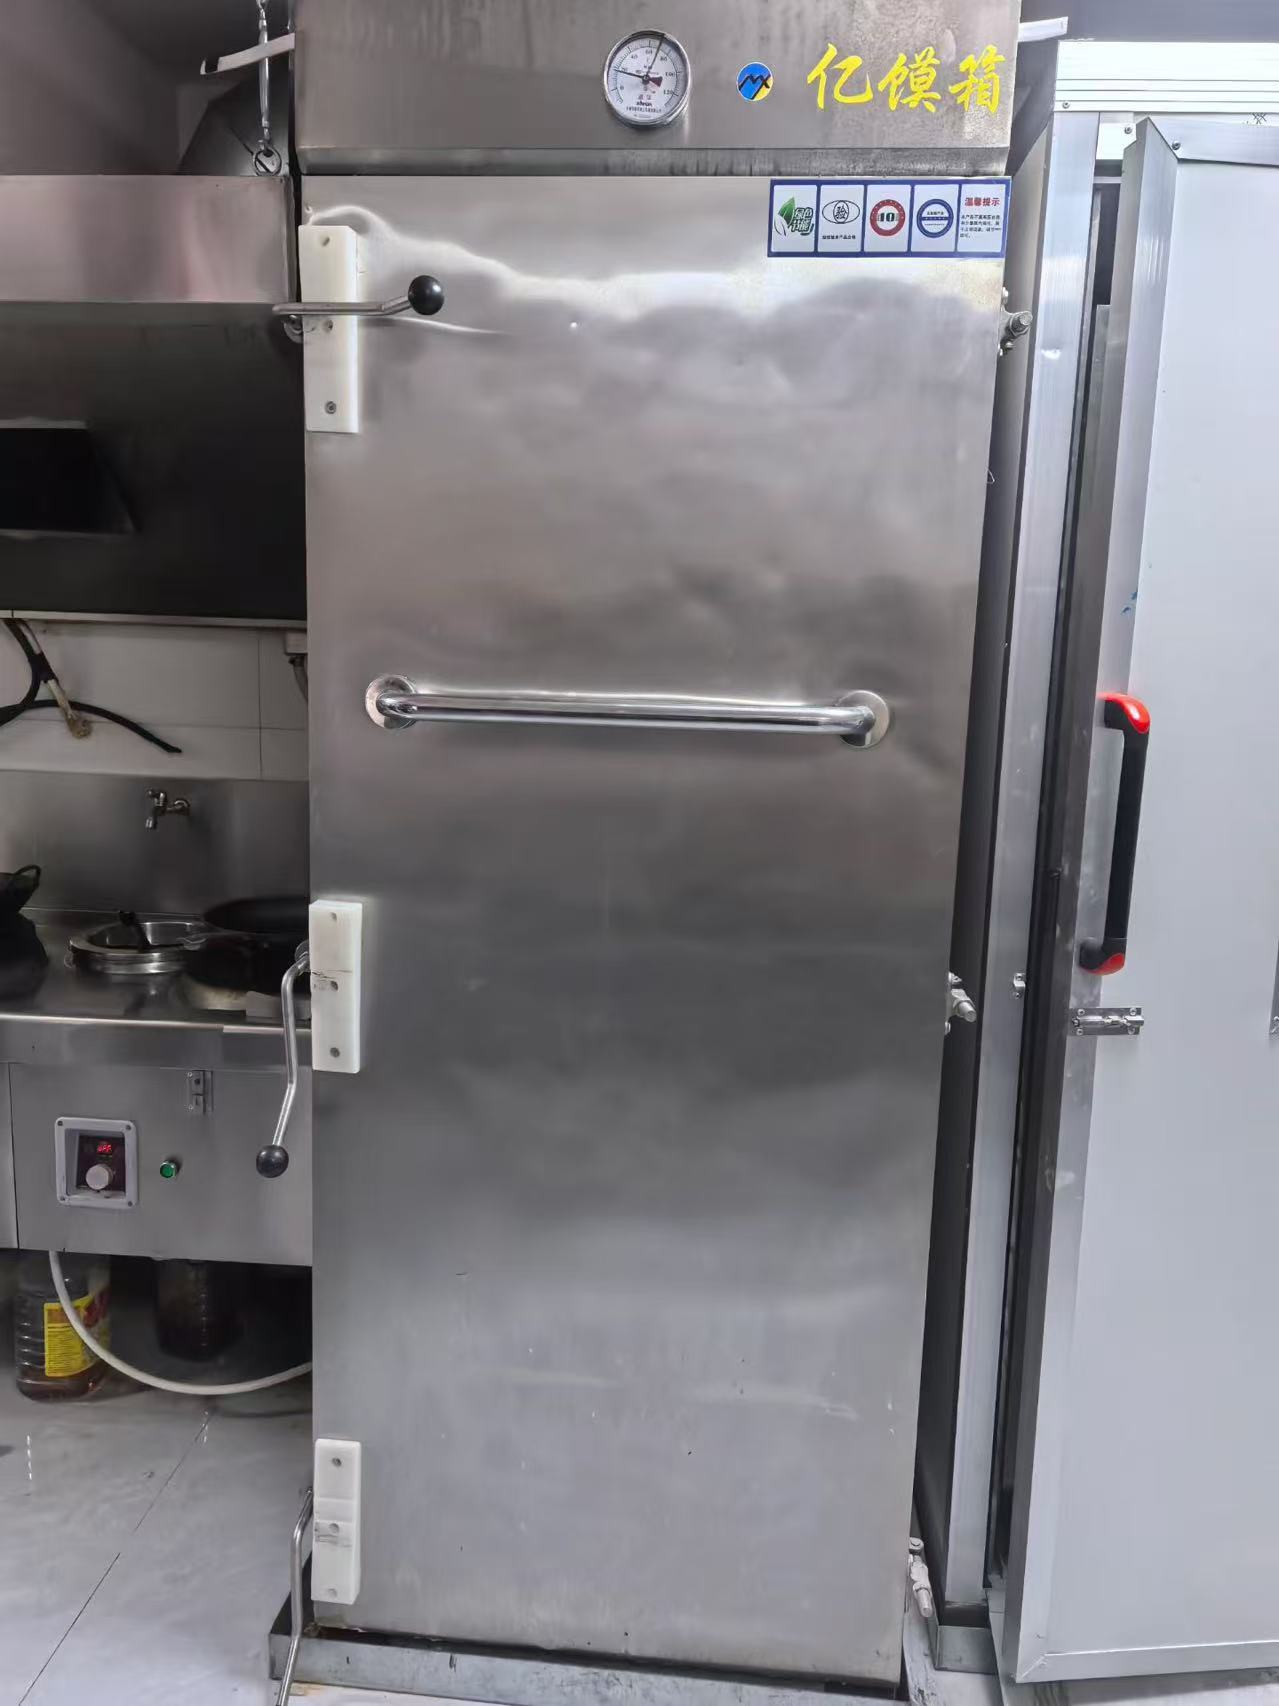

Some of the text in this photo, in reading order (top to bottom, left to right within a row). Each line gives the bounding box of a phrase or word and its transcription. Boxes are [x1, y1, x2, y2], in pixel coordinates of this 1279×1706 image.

[806, 42, 1006, 114] 亿馍箱
[964, 197, 1000, 207] 温馨提示
[794, 207, 814, 219] 绿色
[791, 218, 812, 232] 节能
